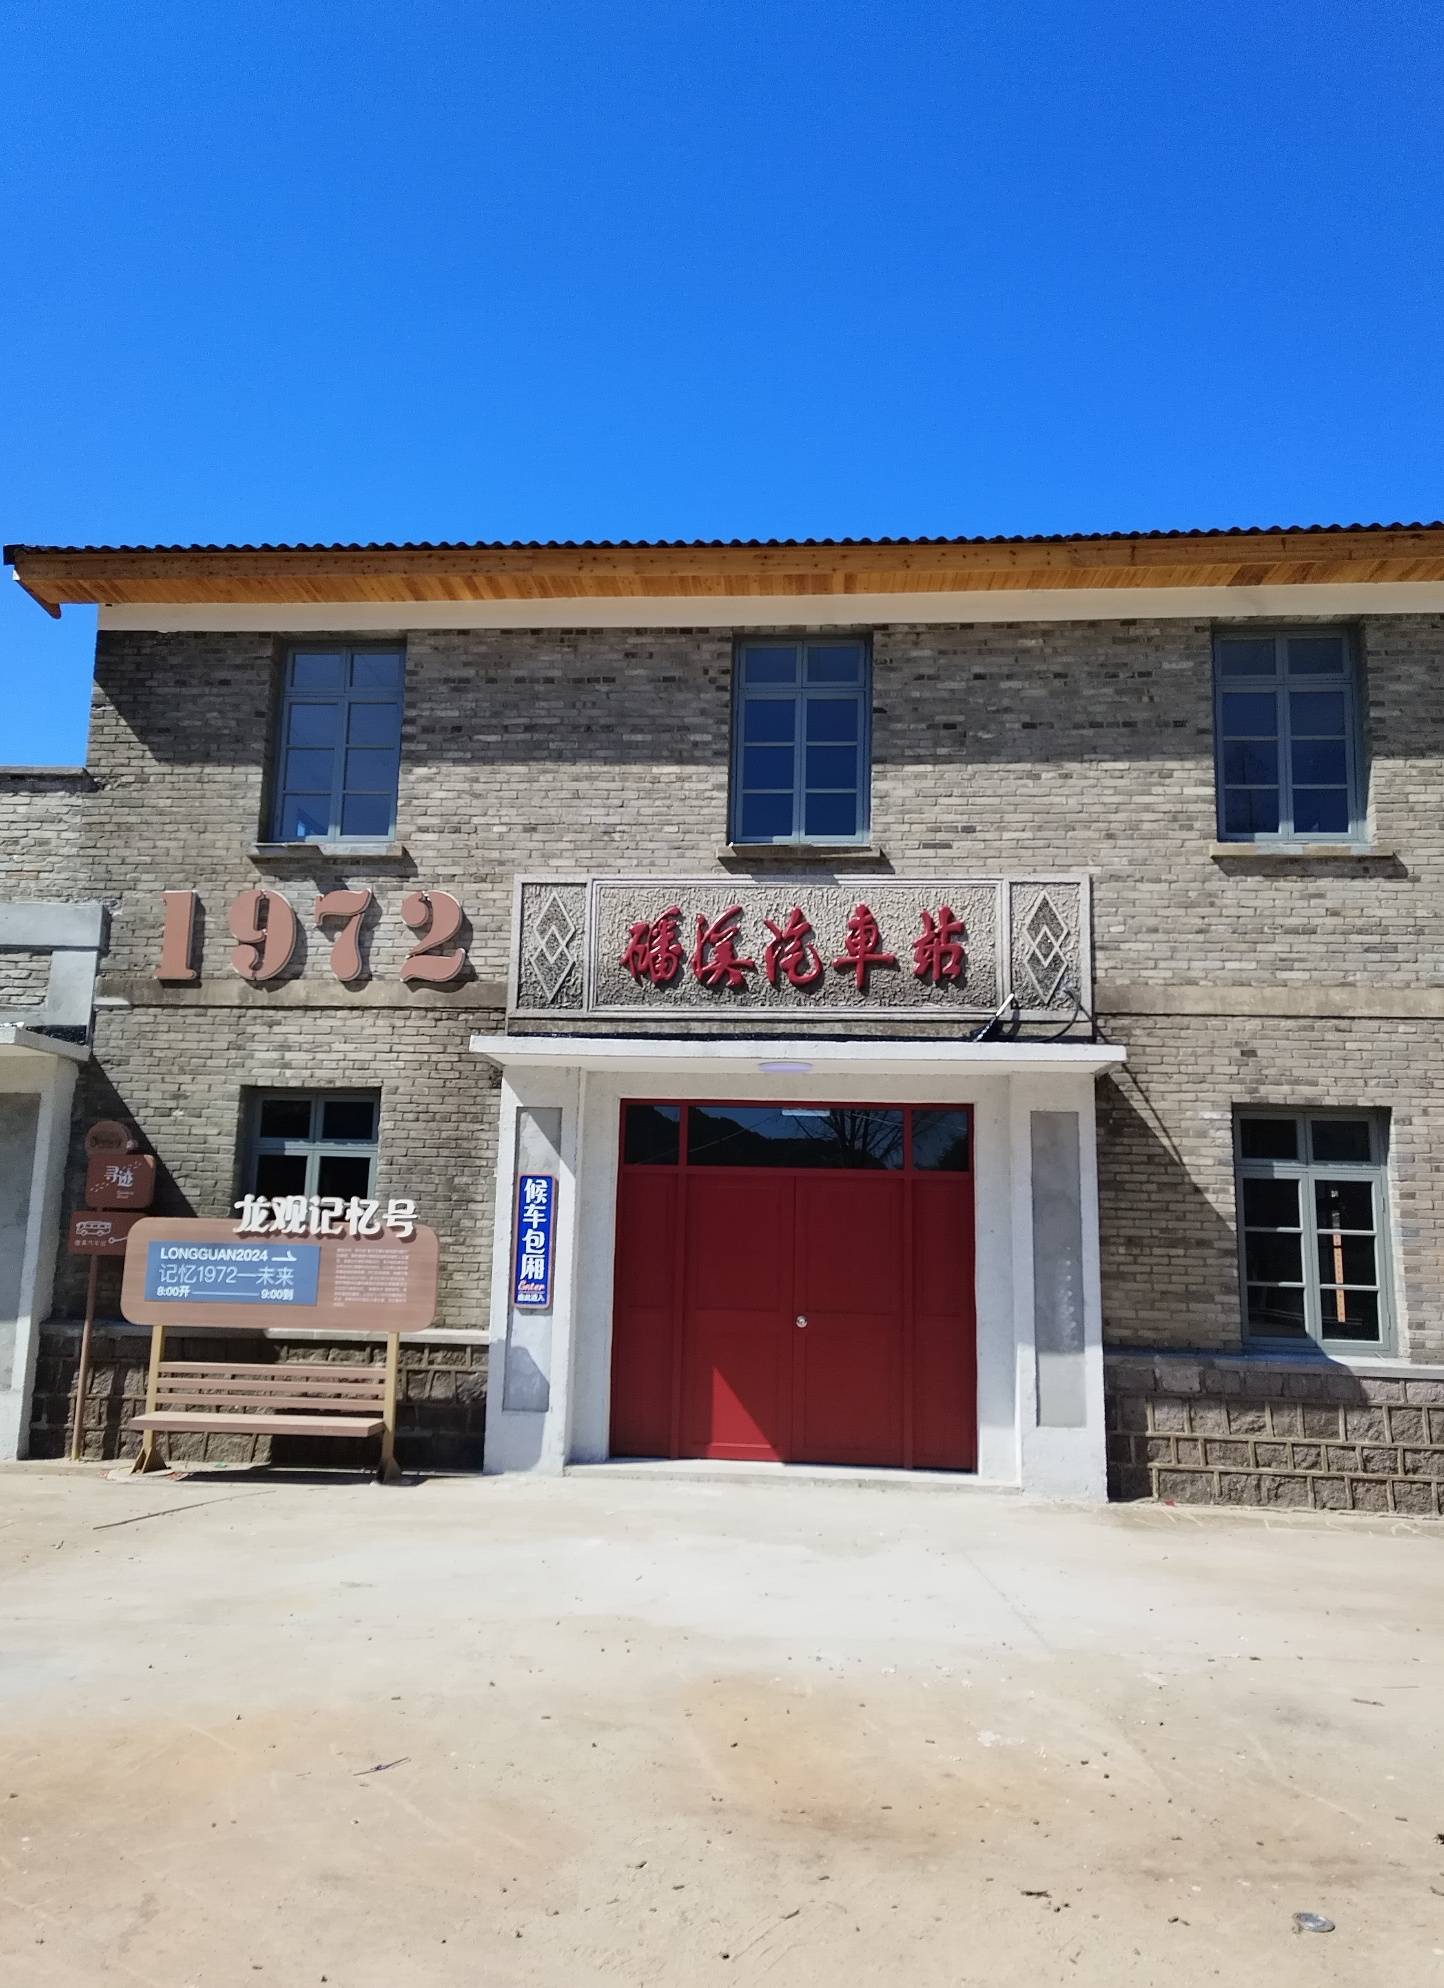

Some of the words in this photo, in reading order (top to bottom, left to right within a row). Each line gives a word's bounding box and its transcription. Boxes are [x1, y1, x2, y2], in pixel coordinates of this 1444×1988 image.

[153, 888, 466, 983] 1972
[232, 1193, 418, 1238] 龙观记忆号
[520, 1178, 549, 1280] 候车包厢
[160, 1247, 268, 1262] LONGGUAN2024
